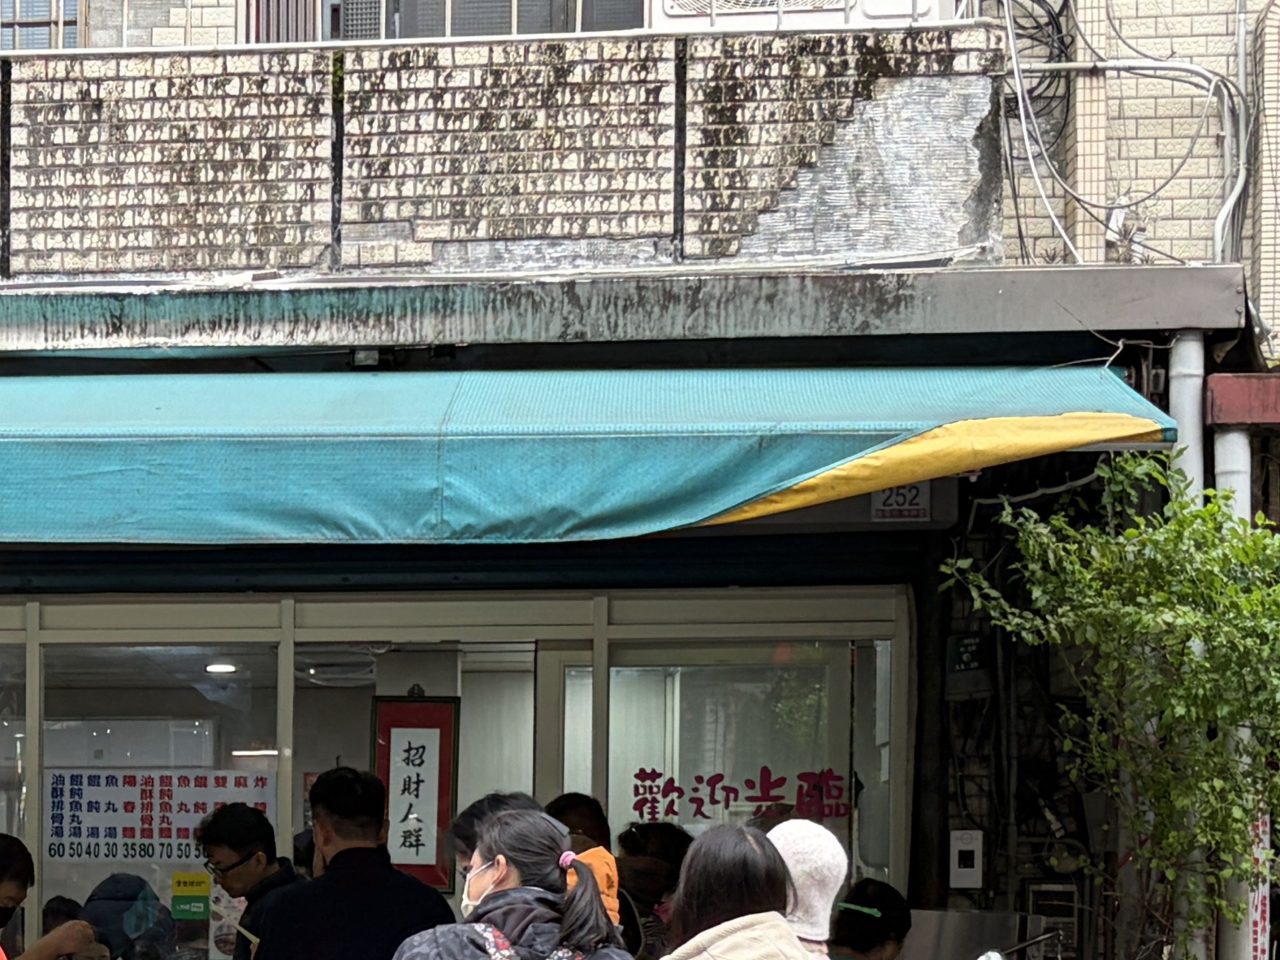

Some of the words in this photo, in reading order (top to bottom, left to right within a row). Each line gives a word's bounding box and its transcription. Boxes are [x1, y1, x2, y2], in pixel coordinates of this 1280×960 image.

[881, 485, 920, 507] 252
[50, 773, 65, 839] 油酥排骨湯
[69, 774, 84, 840] 餛飩魚丸湯
[86, 774, 101, 840] 餛飩湯
[103, 774, 119, 840] 魚丸湯
[399, 740, 426, 857] 招財人群
[48, 842, 66, 859] 60
[69, 841, 83, 859] 50
[85, 841, 100, 859] 40
[103, 841, 119, 859] 30
[122, 841, 138, 859] 35
[138, 842, 155, 859] 80
[159, 842, 173, 859] 70
[176, 842, 191, 859] 50
